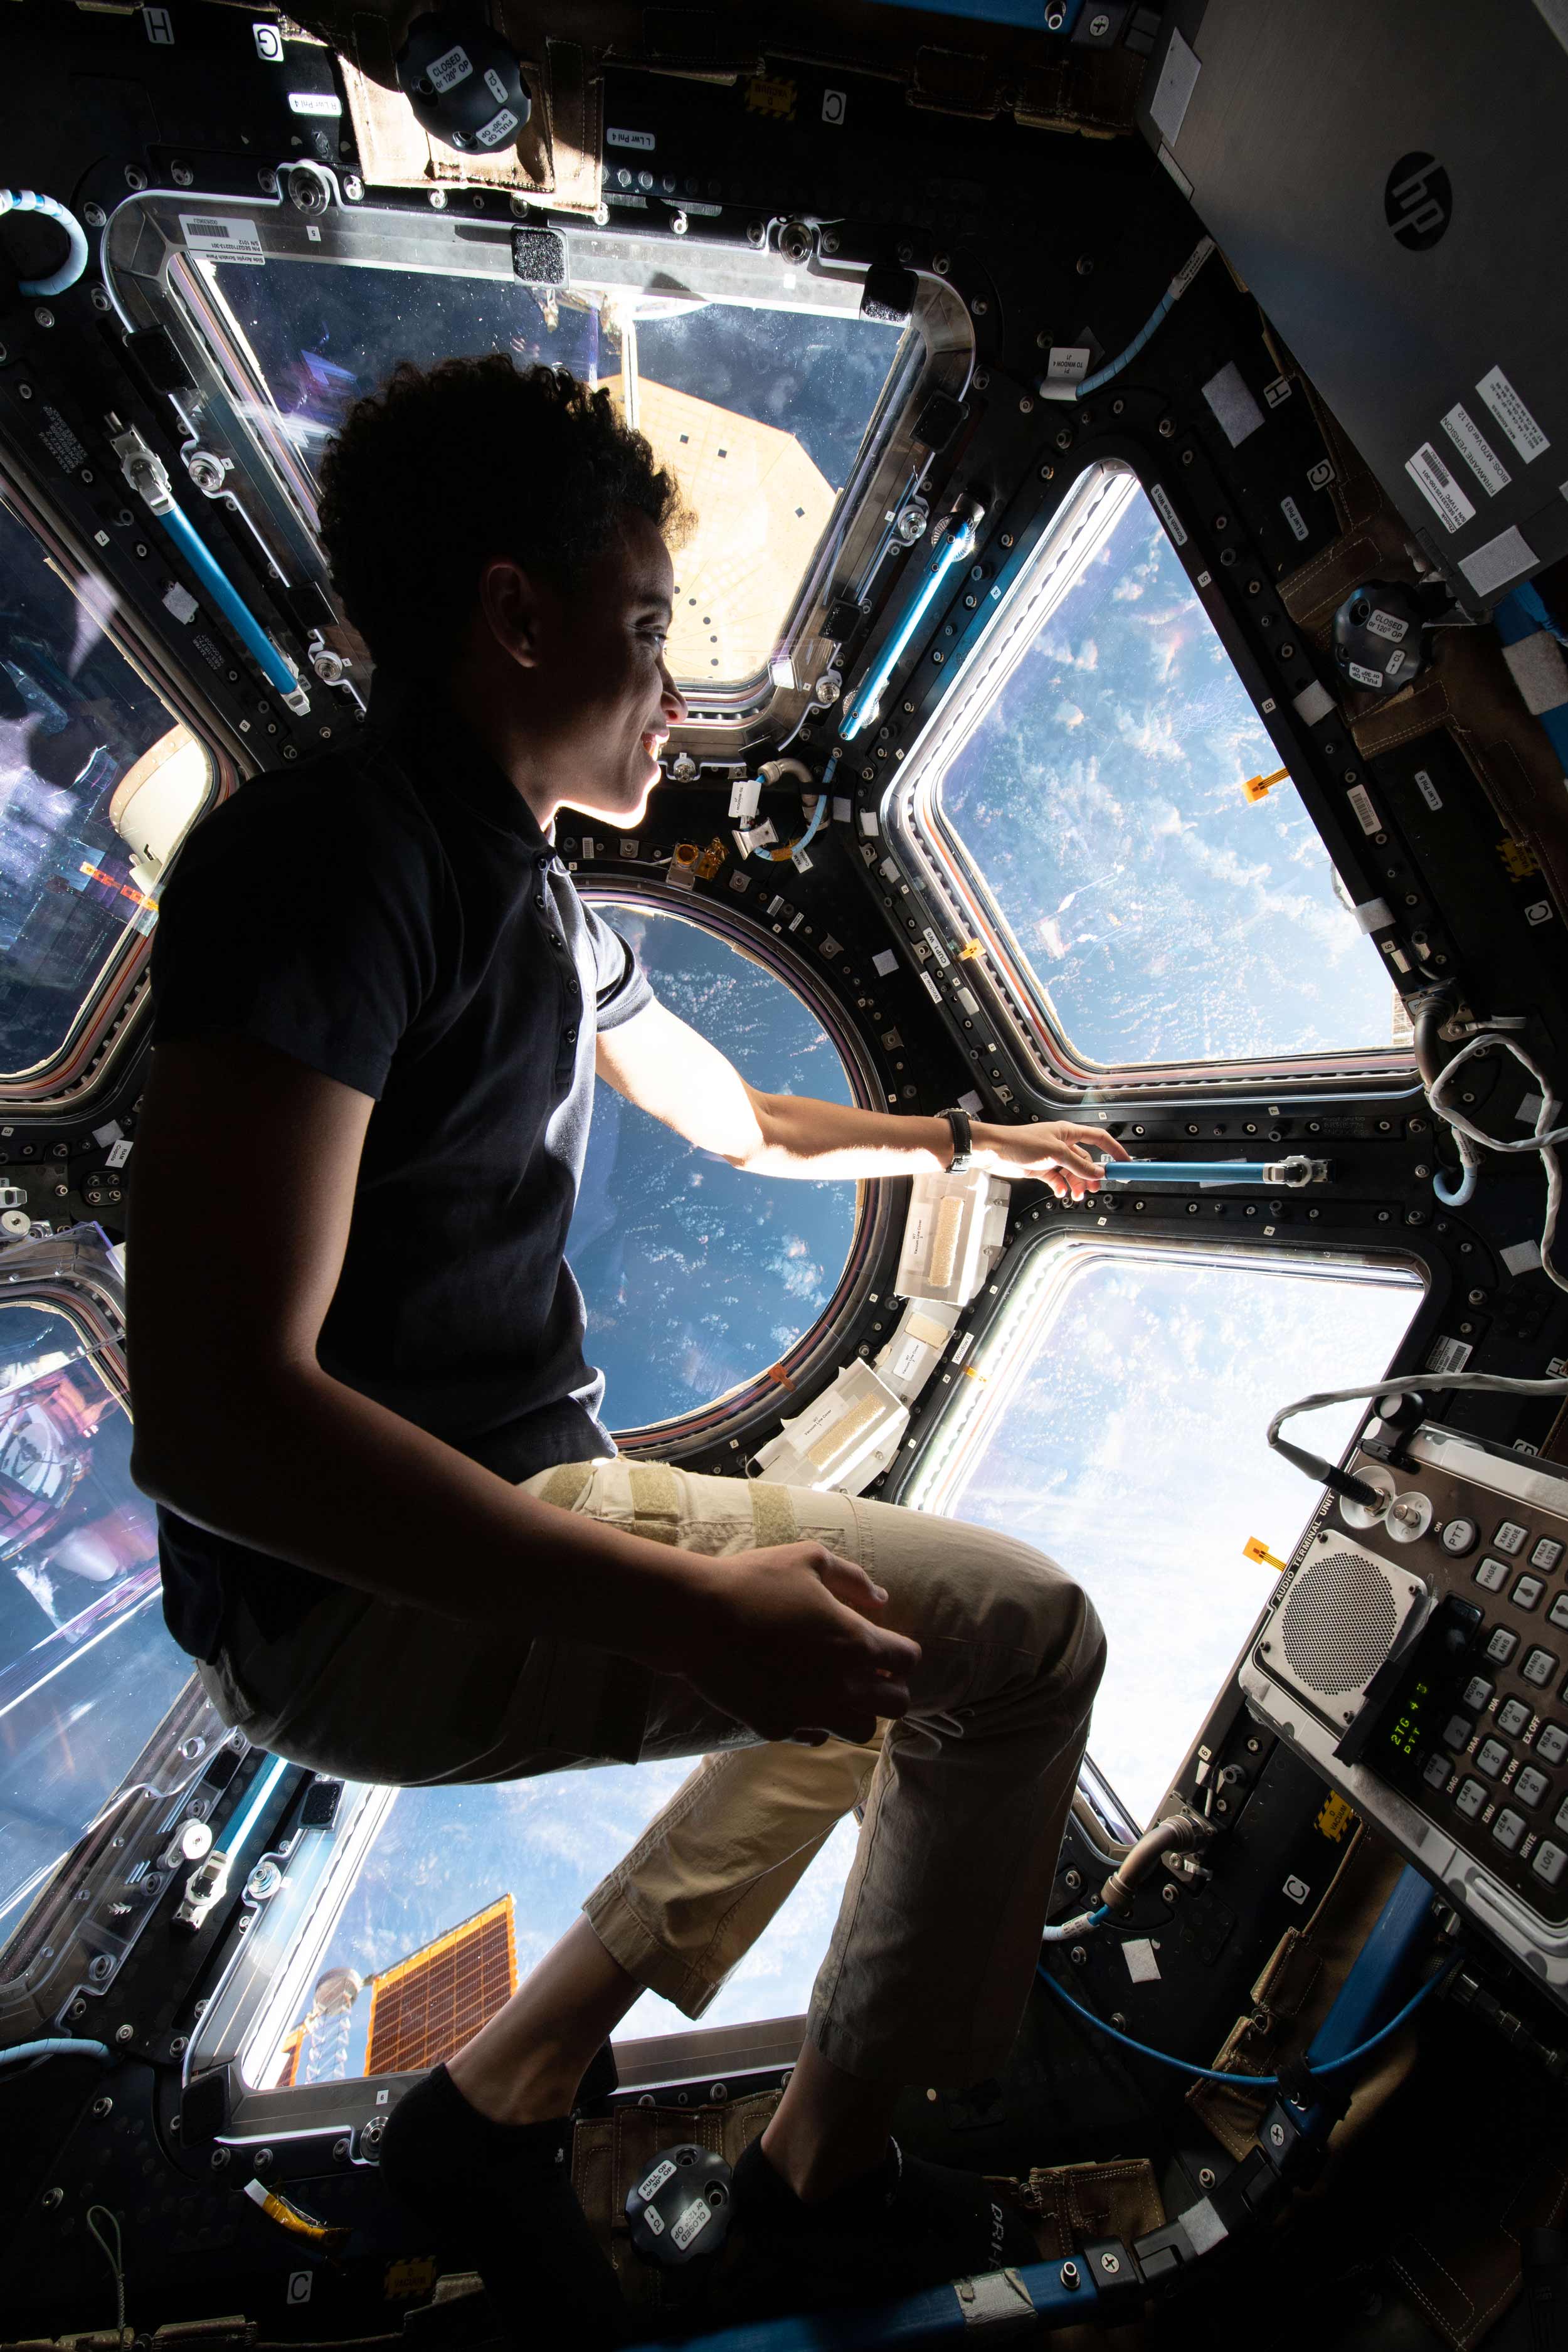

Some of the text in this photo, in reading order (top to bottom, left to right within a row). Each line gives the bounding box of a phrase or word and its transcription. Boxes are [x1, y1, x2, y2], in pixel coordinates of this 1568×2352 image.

[144, 9, 170, 42] H
[256, 28, 279, 58] G
[433, 53, 461, 77] CLOSED
[458, 60, 469, 73] OP
[489, 73, 497, 87] CL
[825, 93, 842, 121] C
[481, 130, 491, 139] OP
[488, 120, 513, 143] FULL OP
[612, 132, 617, 140] 4
[618, 134, 630, 142] Pnl
[632, 135, 644, 146] Lwr
[1390, 160, 1445, 234] hp
[1266, 379, 1290, 405] H
[1442, 417, 1496, 494] FIRMWARE VERSION
[1457, 411, 1509, 484] BIOS: M70 Ver.01.12
[1310, 464, 1331, 486] G
[1157, 494, 1165, 505] Win
[1445, 493, 1466, 523] S/N 11VPC
[1163, 506, 1172, 520] Pane
[1287, 506, 1295, 519] Pnl
[1454, 516, 1463, 527] P/N
[1170, 519, 1185, 543] Scratch
[1293, 517, 1303, 531] Lwr
[1441, 512, 1456, 533] Zbook
[1375, 615, 1403, 631] CLOSED
[1391, 631, 1403, 639] OP
[1393, 653, 1402, 663] CL
[1363, 677, 1379, 686] FULL
[1428, 790, 1436, 802] Lwr
[1528, 905, 1549, 921] C
[926, 980, 940, 1002] Window
[110, 1145, 121, 1161] Cupola
[119, 1148, 127, 1160] RAM
[955, 1340, 968, 1361] Window
[1434, 1522, 1443, 1532] ON
[1449, 1525, 1465, 1547] PTT
[1498, 1527, 1512, 1544] XMIT
[1276, 1493, 1335, 1602] AUDIO TERMINAL UNIT
[1505, 1528, 1521, 1549] MODE
[1534, 1542, 1548, 1560] TALK
[1543, 1545, 1558, 1565] LSTN
[1484, 1564, 1497, 1584] PAGE
[1489, 1634, 1502, 1651] DIAL
[1499, 1639, 1510, 1655] ANS
[1525, 1653, 1541, 1676] HANG
[1537, 1663, 1547, 1675] UP
[1465, 1678, 1480, 1700] NODE
[1475, 1690, 1485, 1699] 3
[1488, 1698, 1500, 1712] DIA
[1500, 1703, 1515, 1724] CPLA
[1511, 1715, 1521, 1723] 6
[1455, 1729, 1465, 1738] 2
[1522, 1715, 1541, 1744] EX OFF
[1466, 1736, 1480, 1754] DAA
[1540, 1731, 1553, 1747] RSA
[1552, 1741, 1562, 1750] 9
[1481, 1746, 1492, 1759] CF
[1501, 1759, 1520, 1785] EX ON
[1518, 1772, 1532, 1790] ESA
[1446, 1776, 1459, 1794] DAG
[1459, 1784, 1472, 1802] LAB
[1530, 1783, 1539, 1793] 8
[1470, 1795, 1479, 1804] 4
[1330, 1805, 1348, 1830] VACUUM
[1481, 1804, 1496, 1823] EMU
[1496, 1814, 1508, 1833] JEM
[1506, 1826, 1517, 1836] 7
[1519, 1832, 1538, 1859] BRITE
[1540, 1850, 1555, 1870] LOG
[1287, 1880, 1305, 1899] C
[642, 2164, 667, 2192] FULL OP
[647, 2166, 672, 2197] or OP
[653, 2219, 664, 2232] CL
[674, 2201, 703, 2240] or OP
[681, 2211, 707, 2243] CLOSED
[291, 2273, 309, 2301] C
